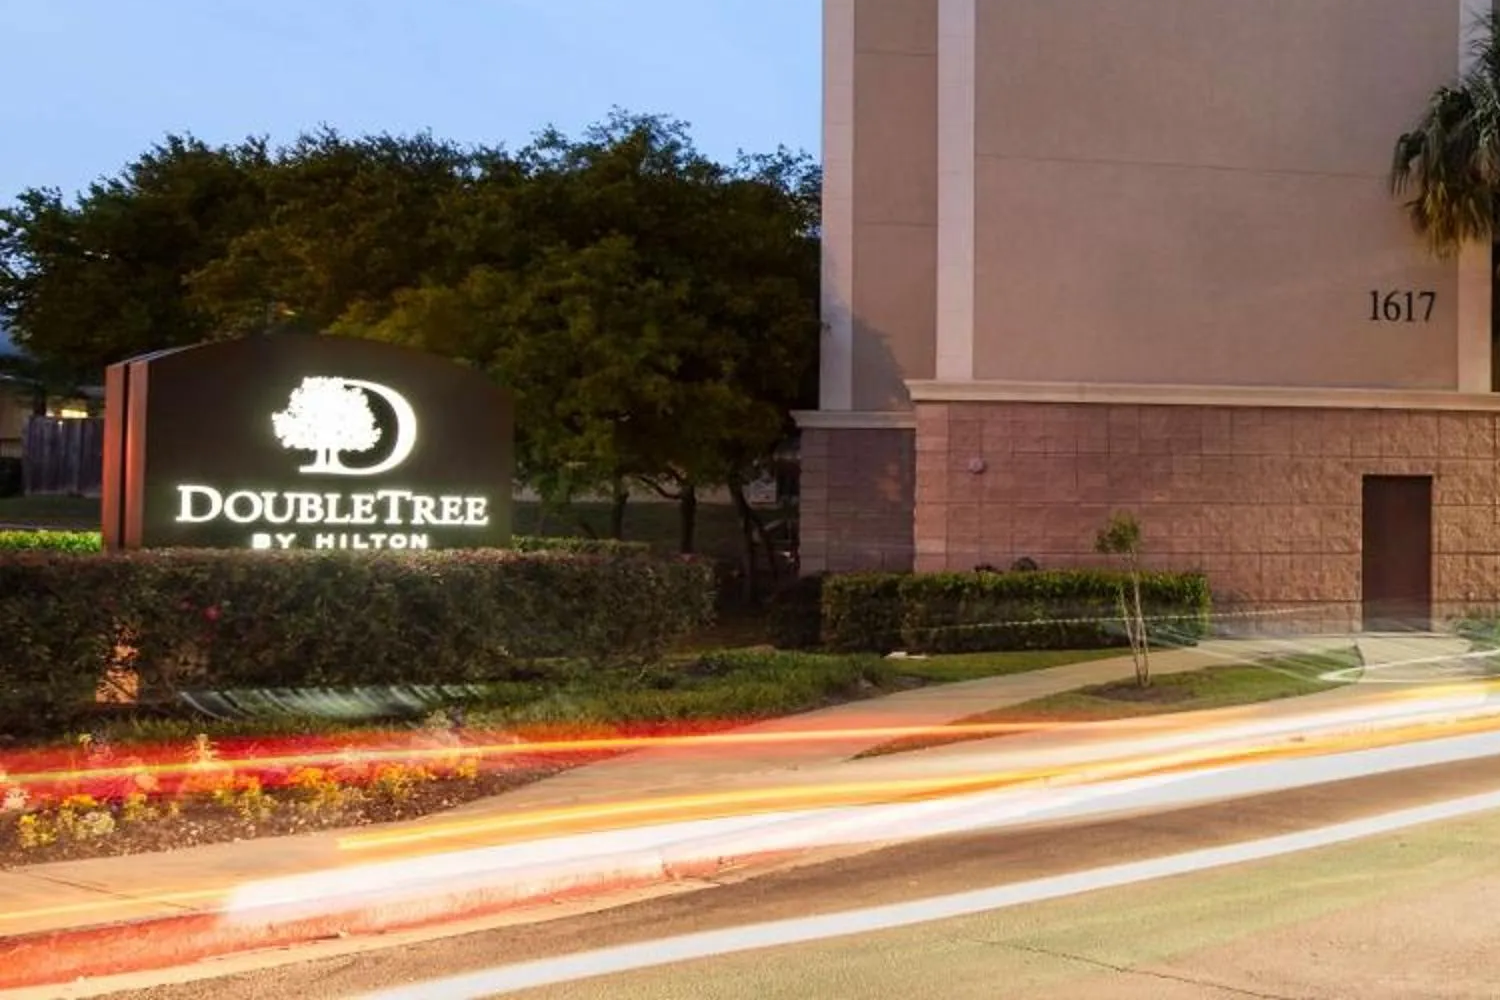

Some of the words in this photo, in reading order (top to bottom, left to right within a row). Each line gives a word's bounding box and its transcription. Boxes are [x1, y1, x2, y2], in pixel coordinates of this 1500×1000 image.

[1369, 290, 1437, 322] 1617
[176, 485, 488, 526] DOUBLETREE
[251, 533, 297, 549] BY
[315, 533, 428, 549] HILTON
